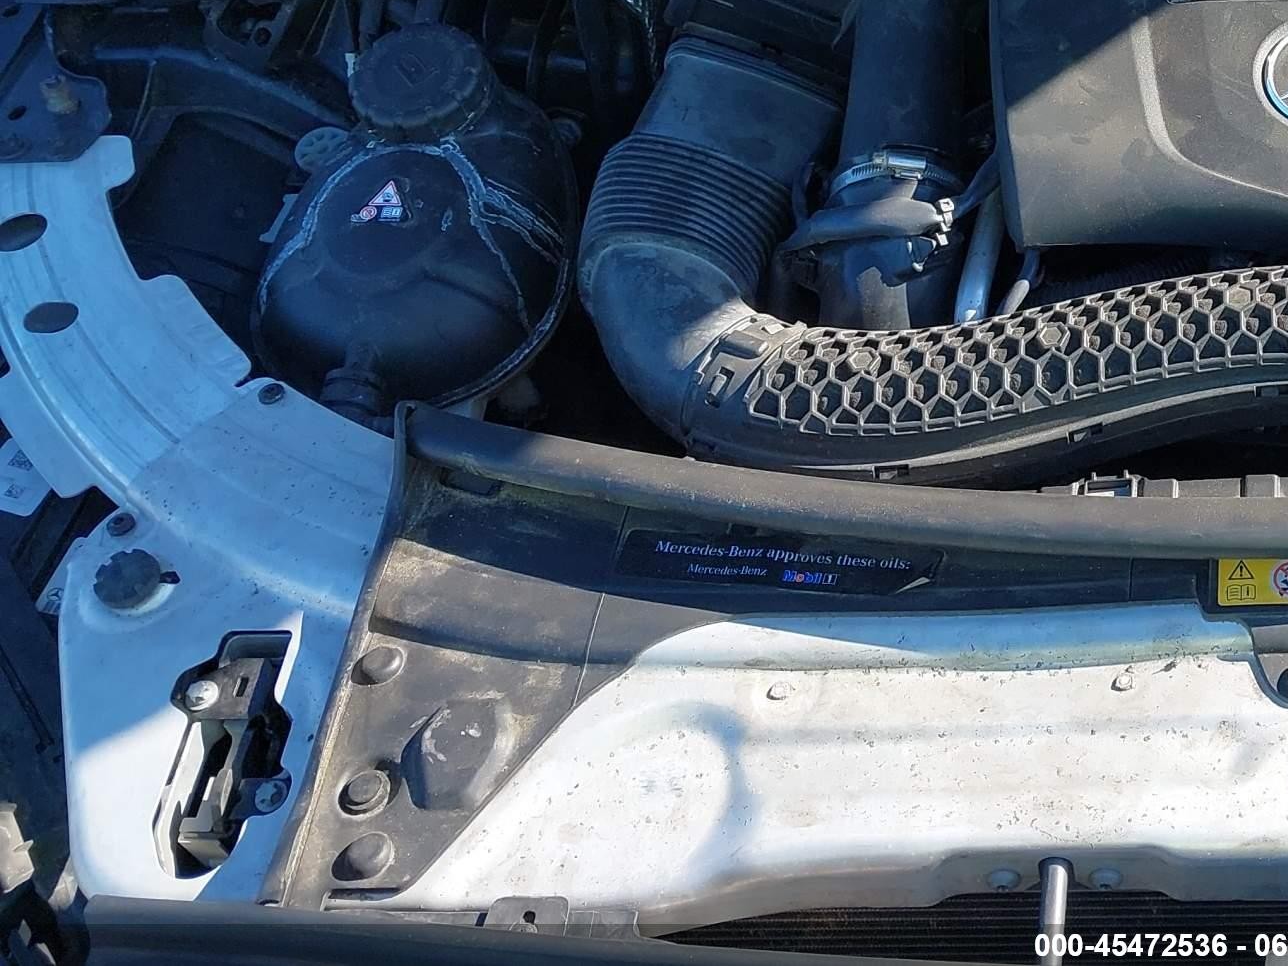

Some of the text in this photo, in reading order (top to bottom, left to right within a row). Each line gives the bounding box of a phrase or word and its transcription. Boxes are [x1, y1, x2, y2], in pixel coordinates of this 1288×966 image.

[655, 540, 912, 570] Mercedes-Benz approves these oils:
[687, 563, 768, 577] Mercedes-Benz
